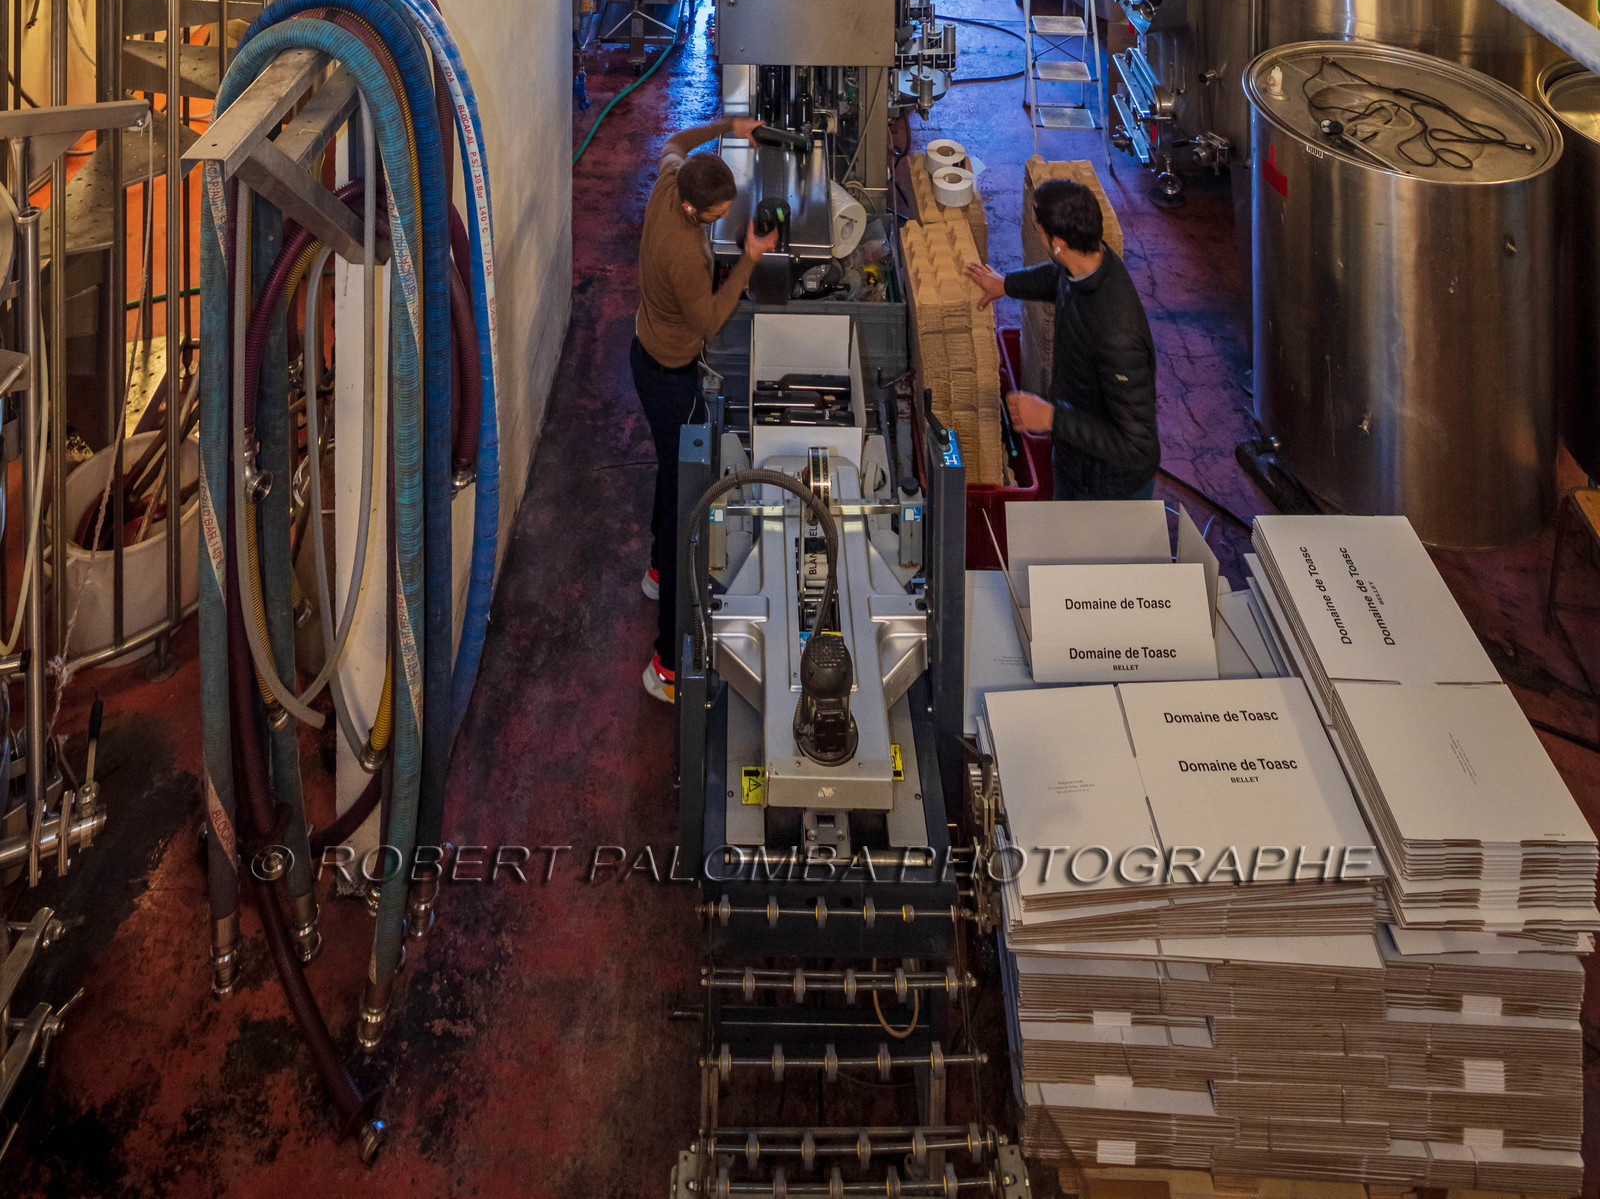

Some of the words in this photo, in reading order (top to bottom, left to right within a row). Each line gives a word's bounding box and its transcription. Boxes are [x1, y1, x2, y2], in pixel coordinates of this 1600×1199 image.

[443, 66, 455, 83] FDA
[474, 174, 482, 184] 10
[479, 205, 488, 233] 140°C
[485, 259, 493, 277] FDA
[203, 519, 217, 541] BAR
[1299, 546, 1319, 577] Toasc
[1339, 547, 1360, 578] Toasc
[1315, 578, 1327, 592] de
[1356, 579, 1368, 593] de
[1065, 598, 1117, 609] Domaine
[1120, 598, 1135, 609] de
[1136, 597, 1172, 609] Toasc
[1322, 595, 1352, 645] Domaine
[1364, 595, 1396, 646] Domaine
[1069, 647, 1121, 659] Domaine
[1125, 647, 1139, 658] de
[1141, 646, 1177, 658] Toasc
[1163, 711, 1220, 724] Domaine
[1223, 711, 1239, 722] de
[1239, 710, 1279, 721] Toasc
[1178, 759, 1237, 772] Domaine
[1240, 759, 1257, 771] de
[1257, 758, 1298, 770] Toasc
